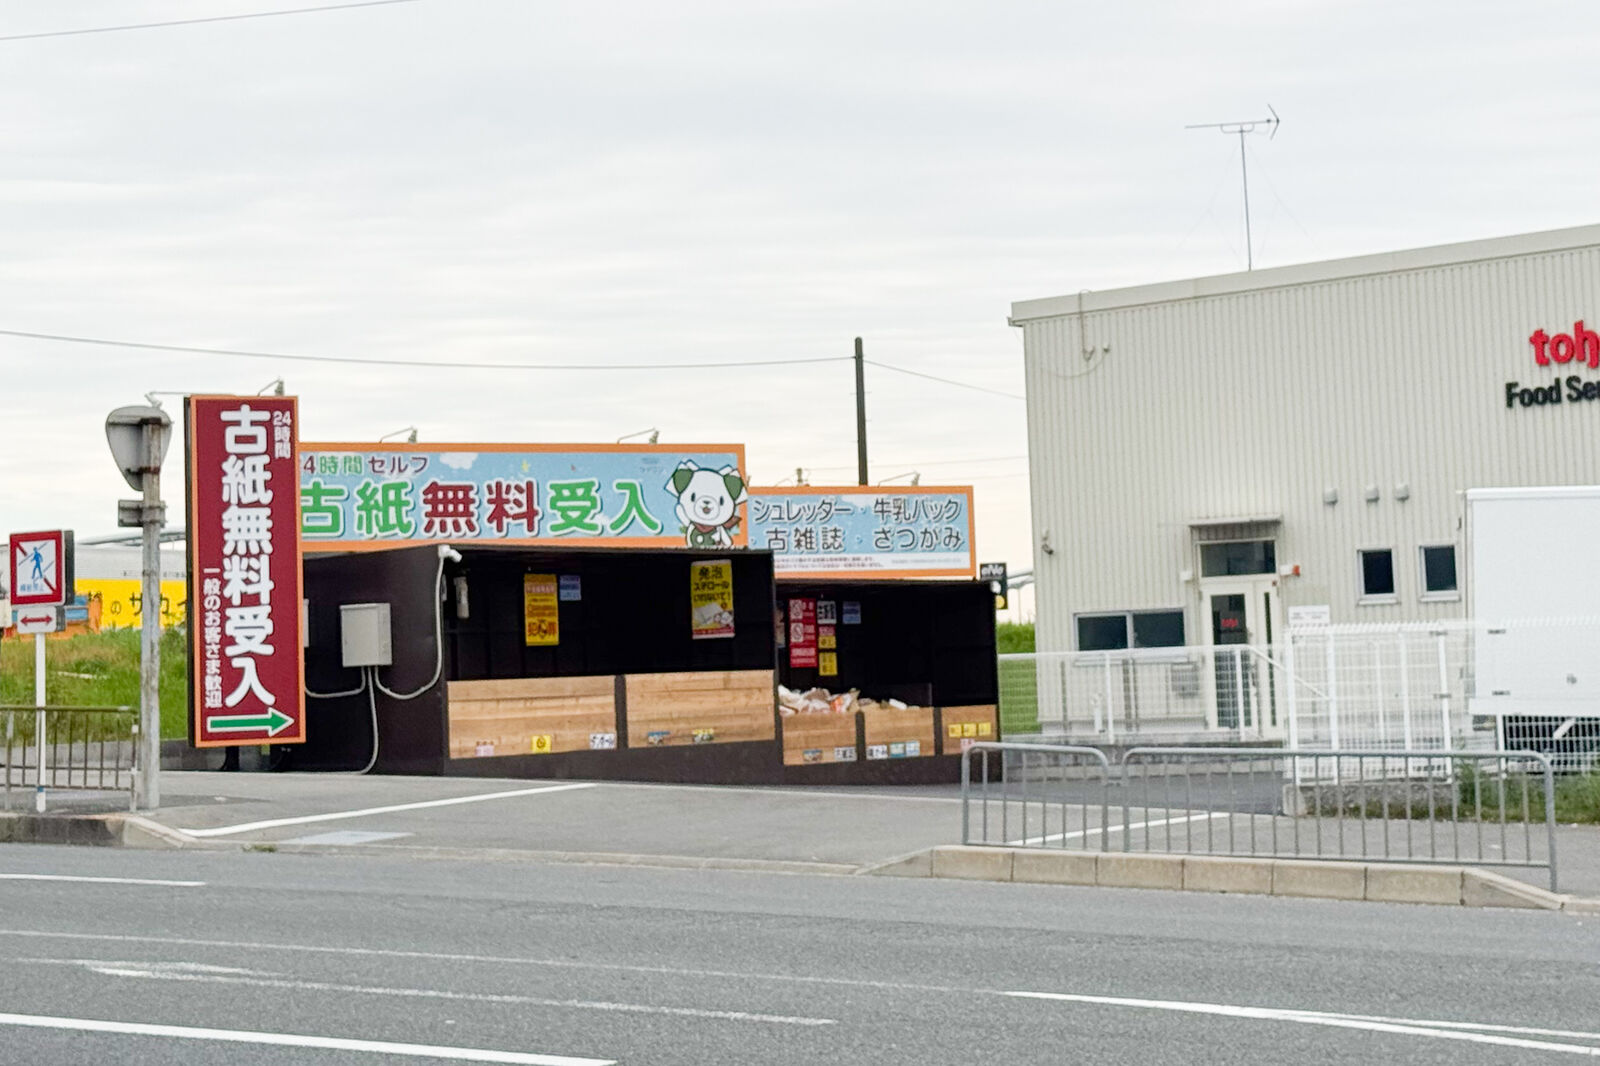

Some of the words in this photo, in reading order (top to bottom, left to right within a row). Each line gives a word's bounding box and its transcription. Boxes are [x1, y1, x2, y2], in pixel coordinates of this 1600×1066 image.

[1529, 320, 1600, 368] toh
[1505, 377, 1561, 408] Food
[300, 479, 664, 540] 古紙無料受入
[753, 498, 852, 523] シュレッダー
[219, 404, 277, 708] 古紙無料受入
[766, 526, 845, 553] 古雑誌
